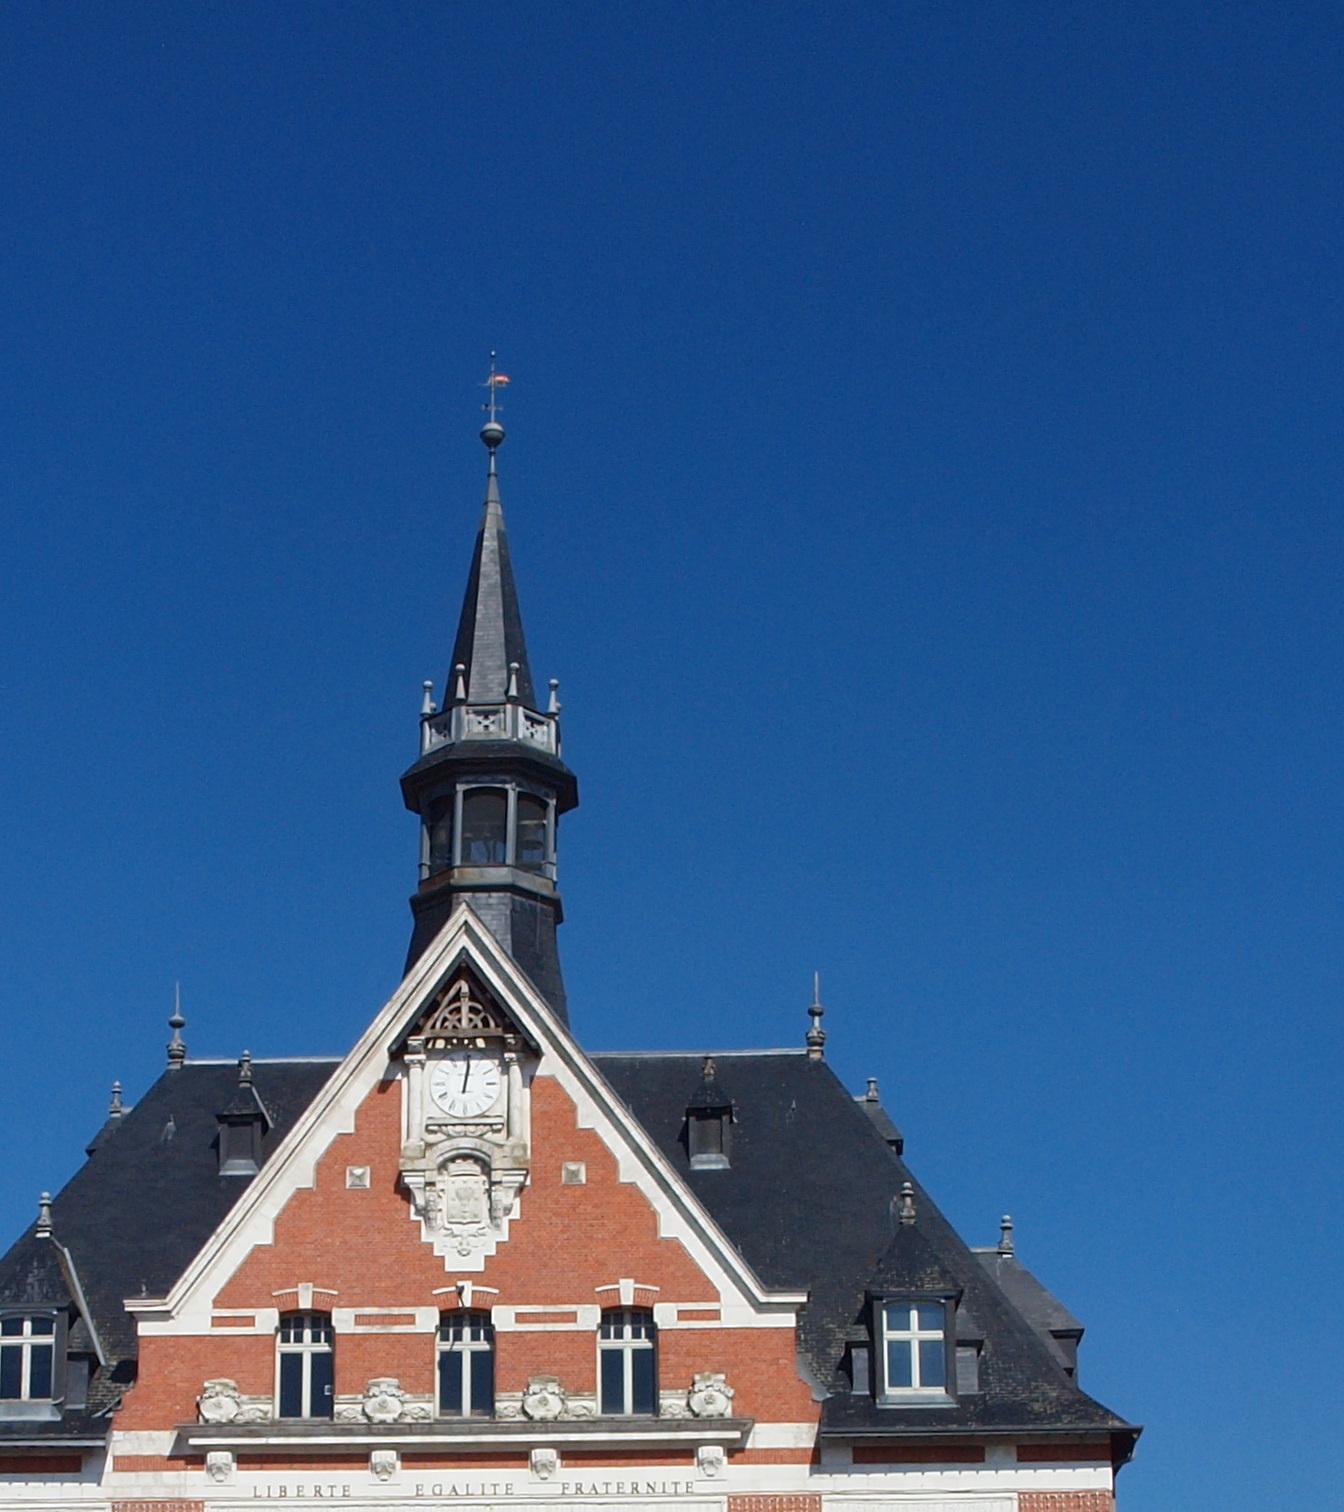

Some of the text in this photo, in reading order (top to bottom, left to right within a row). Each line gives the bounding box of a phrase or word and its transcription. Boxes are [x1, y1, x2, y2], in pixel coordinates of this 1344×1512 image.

[253, 1481, 694, 1498] LIBERTE EGALITE FRATERNITE
